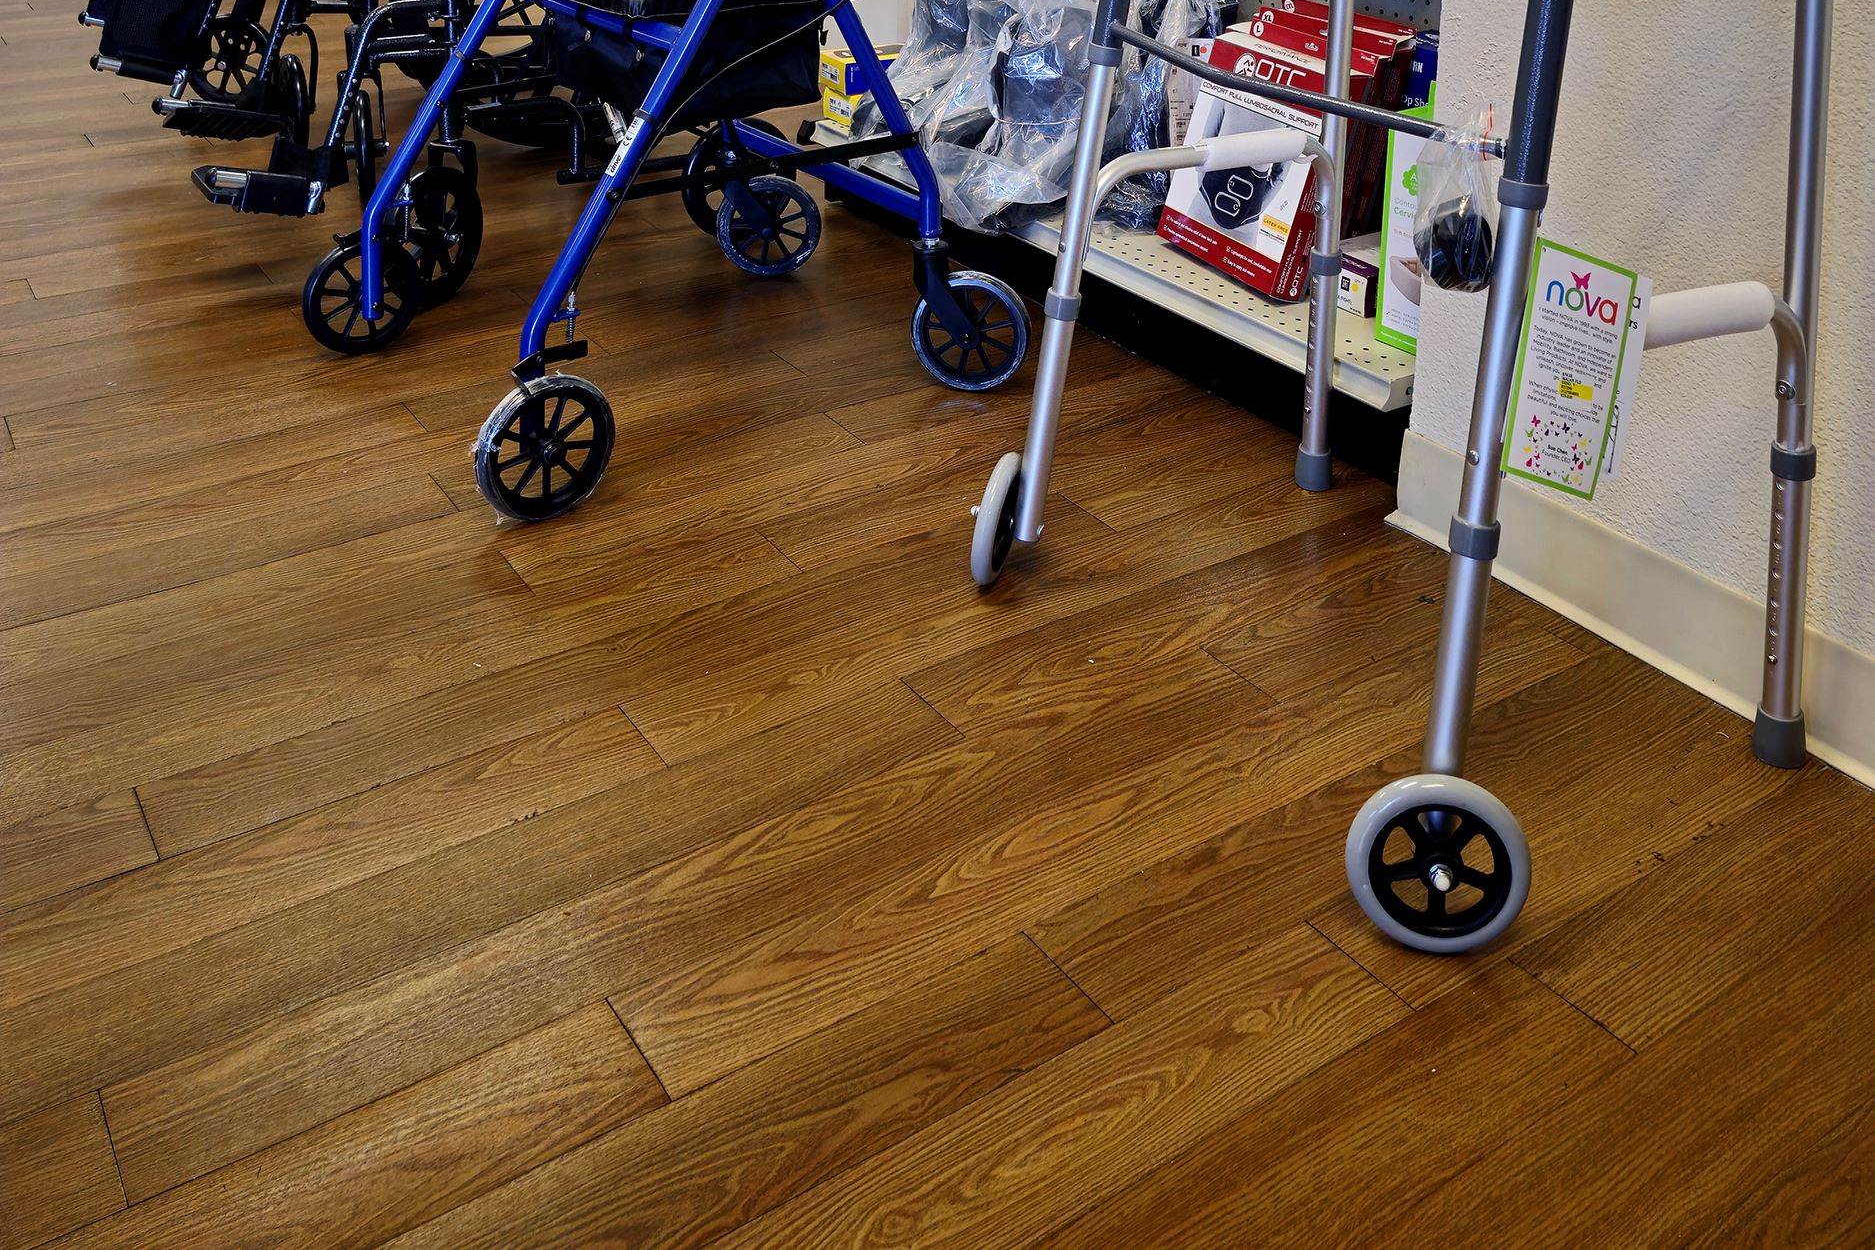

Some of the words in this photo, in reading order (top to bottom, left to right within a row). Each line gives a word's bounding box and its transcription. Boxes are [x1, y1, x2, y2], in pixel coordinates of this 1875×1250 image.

[1263, 12, 1272, 22] XL
[1202, 80, 1229, 95] COMFORT
[1229, 90, 1244, 102] PULL
[1243, 98, 1287, 117] LUMBOSACRAL
[1287, 113, 1319, 130] SUPPORT
[1263, 217, 1277, 229] LATEX
[1545, 280, 1619, 327] nova
